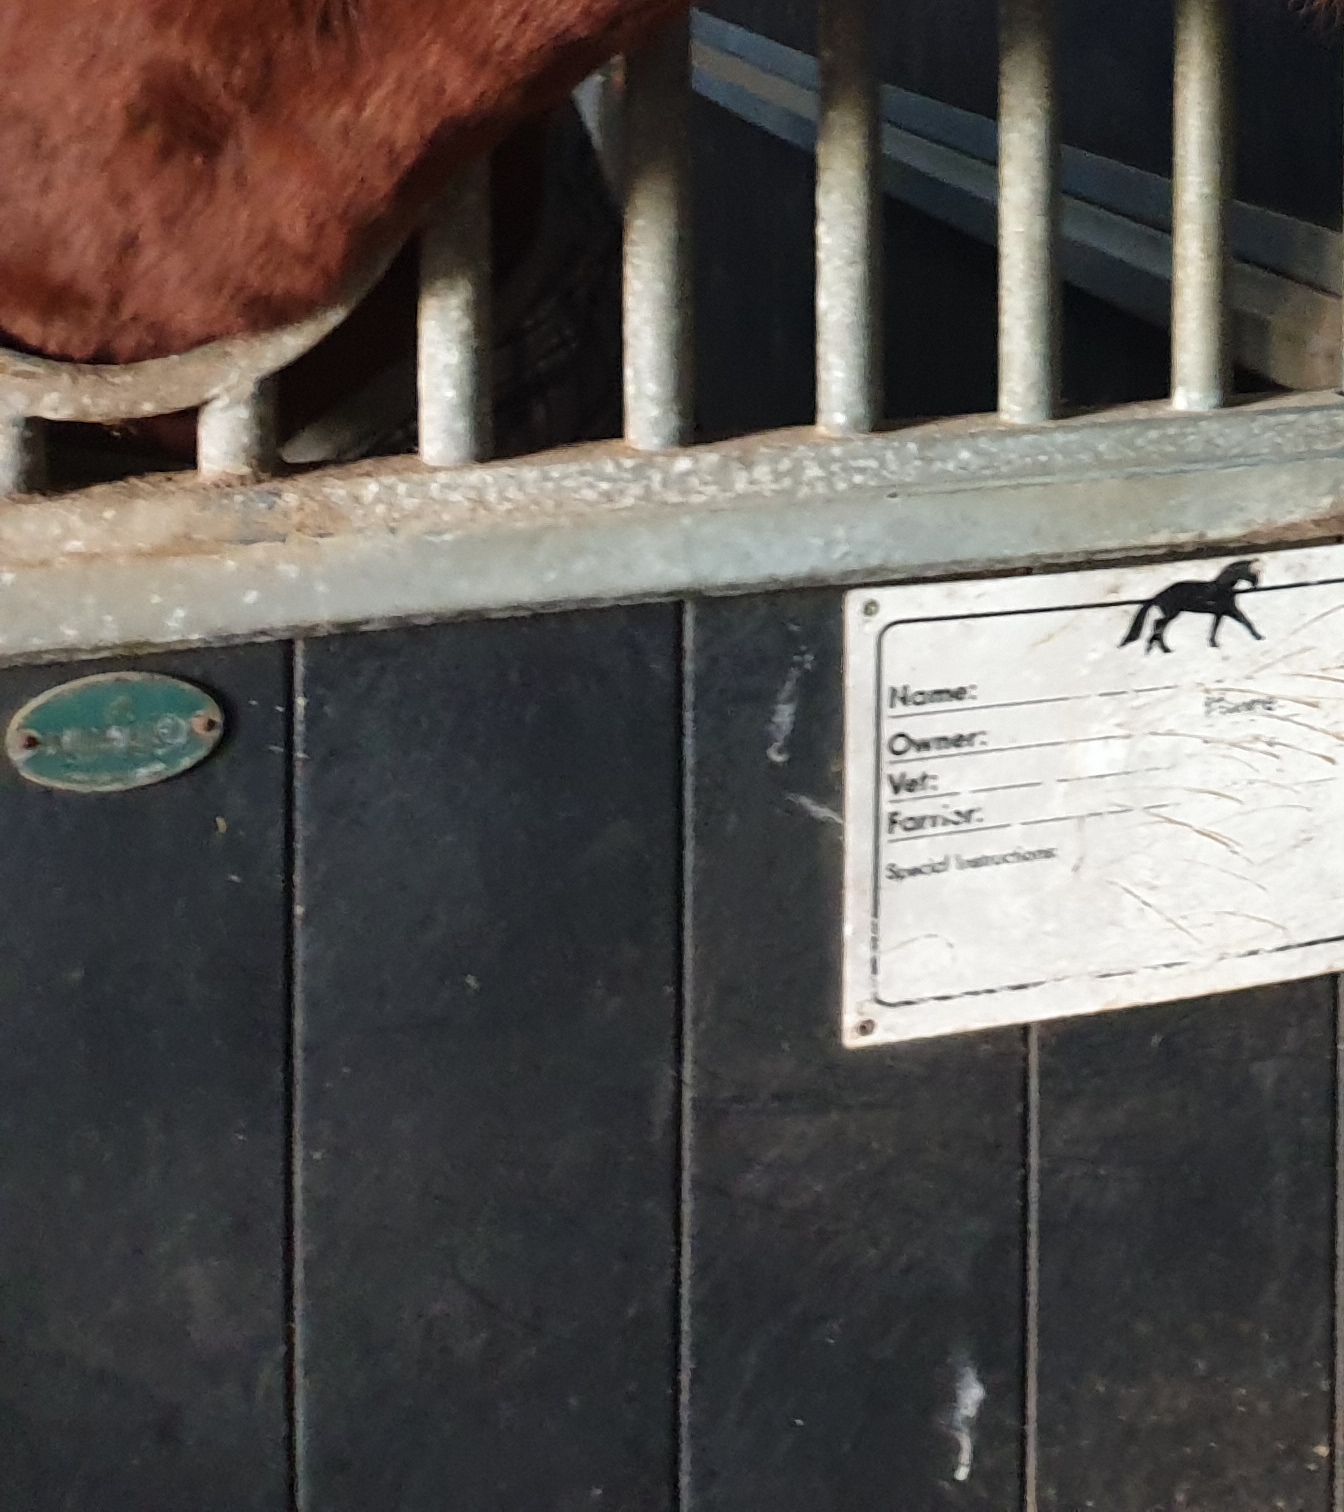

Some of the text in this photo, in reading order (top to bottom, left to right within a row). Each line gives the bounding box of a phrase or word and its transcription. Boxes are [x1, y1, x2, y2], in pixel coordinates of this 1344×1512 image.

[888, 684, 978, 709] Name:
[888, 731, 987, 756] Owner:
[887, 771, 939, 794] Vet:
